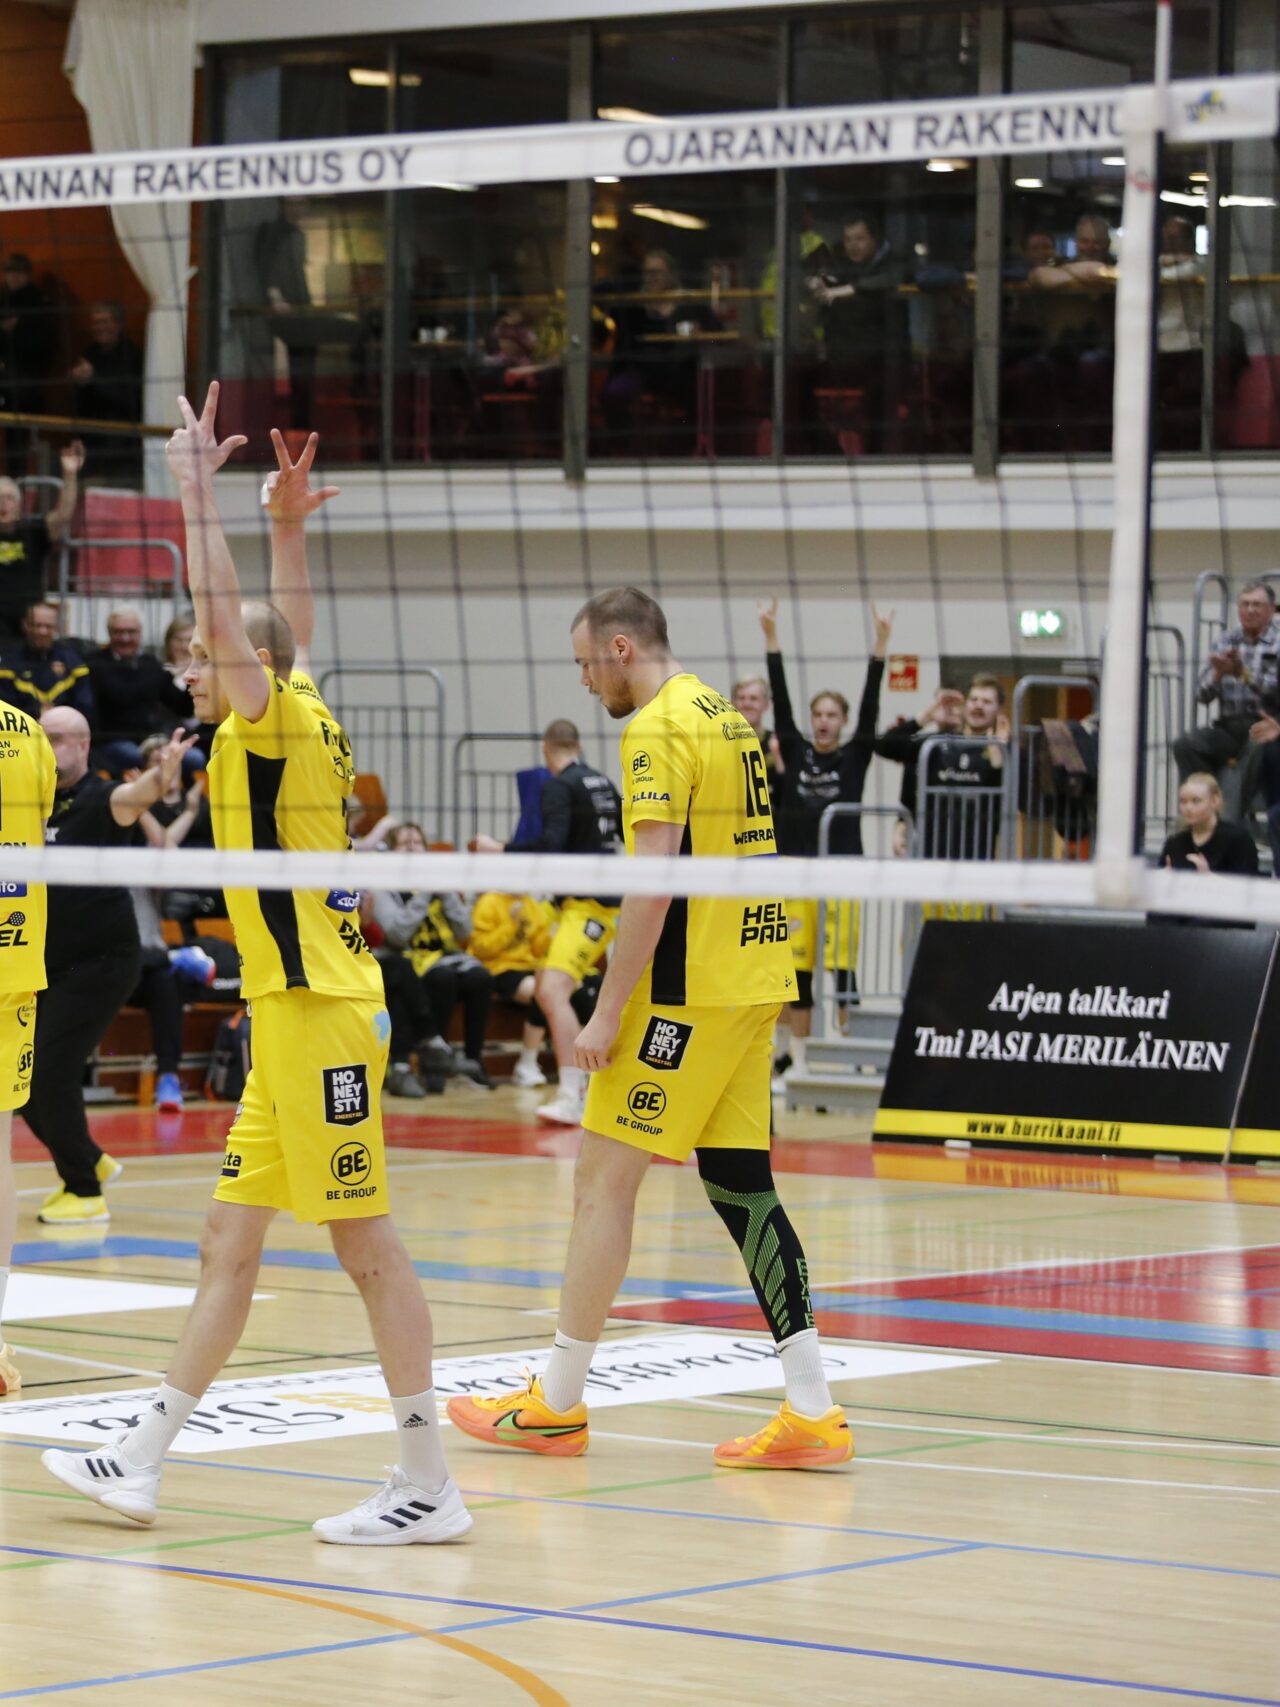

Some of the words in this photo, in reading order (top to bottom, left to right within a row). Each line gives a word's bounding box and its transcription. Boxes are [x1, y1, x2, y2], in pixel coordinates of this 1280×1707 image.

[625, 119, 891, 169] OJARANNAN
[134, 151, 342, 195] RAKENNUS
[358, 147, 413, 182] OY
[7, 749, 20, 758] OY
[632, 754, 648, 771] BE
[742, 750, 771, 818] 16
[742, 902, 787, 926] HEL
[740, 922, 791, 947] PAD
[988, 981, 1061, 1020] Arjen
[1068, 985, 1171, 1019] talkkari
[654, 1021, 678, 1037] HO
[648, 1044, 677, 1060] STY
[651, 1033, 682, 1050] NEY
[914, 1026, 964, 1058] Tmi
[966, 1029, 1032, 1062] PASI
[1033, 1030, 1230, 1073] MERILÄINEN
[332, 1070, 355, 1086] HO
[333, 1082, 363, 1100] NEY
[631, 1090, 662, 1111] BE
[334, 1096, 362, 1113] STY
[616, 1115, 629, 1126] BE
[630, 1120, 663, 1136] GROUP
[967, 1118, 1121, 1142] www.hurrikaani.fi
[337, 1149, 368, 1178] BE
[326, 1190, 341, 1200] BE
[343, 1186, 377, 1200] GROUP
